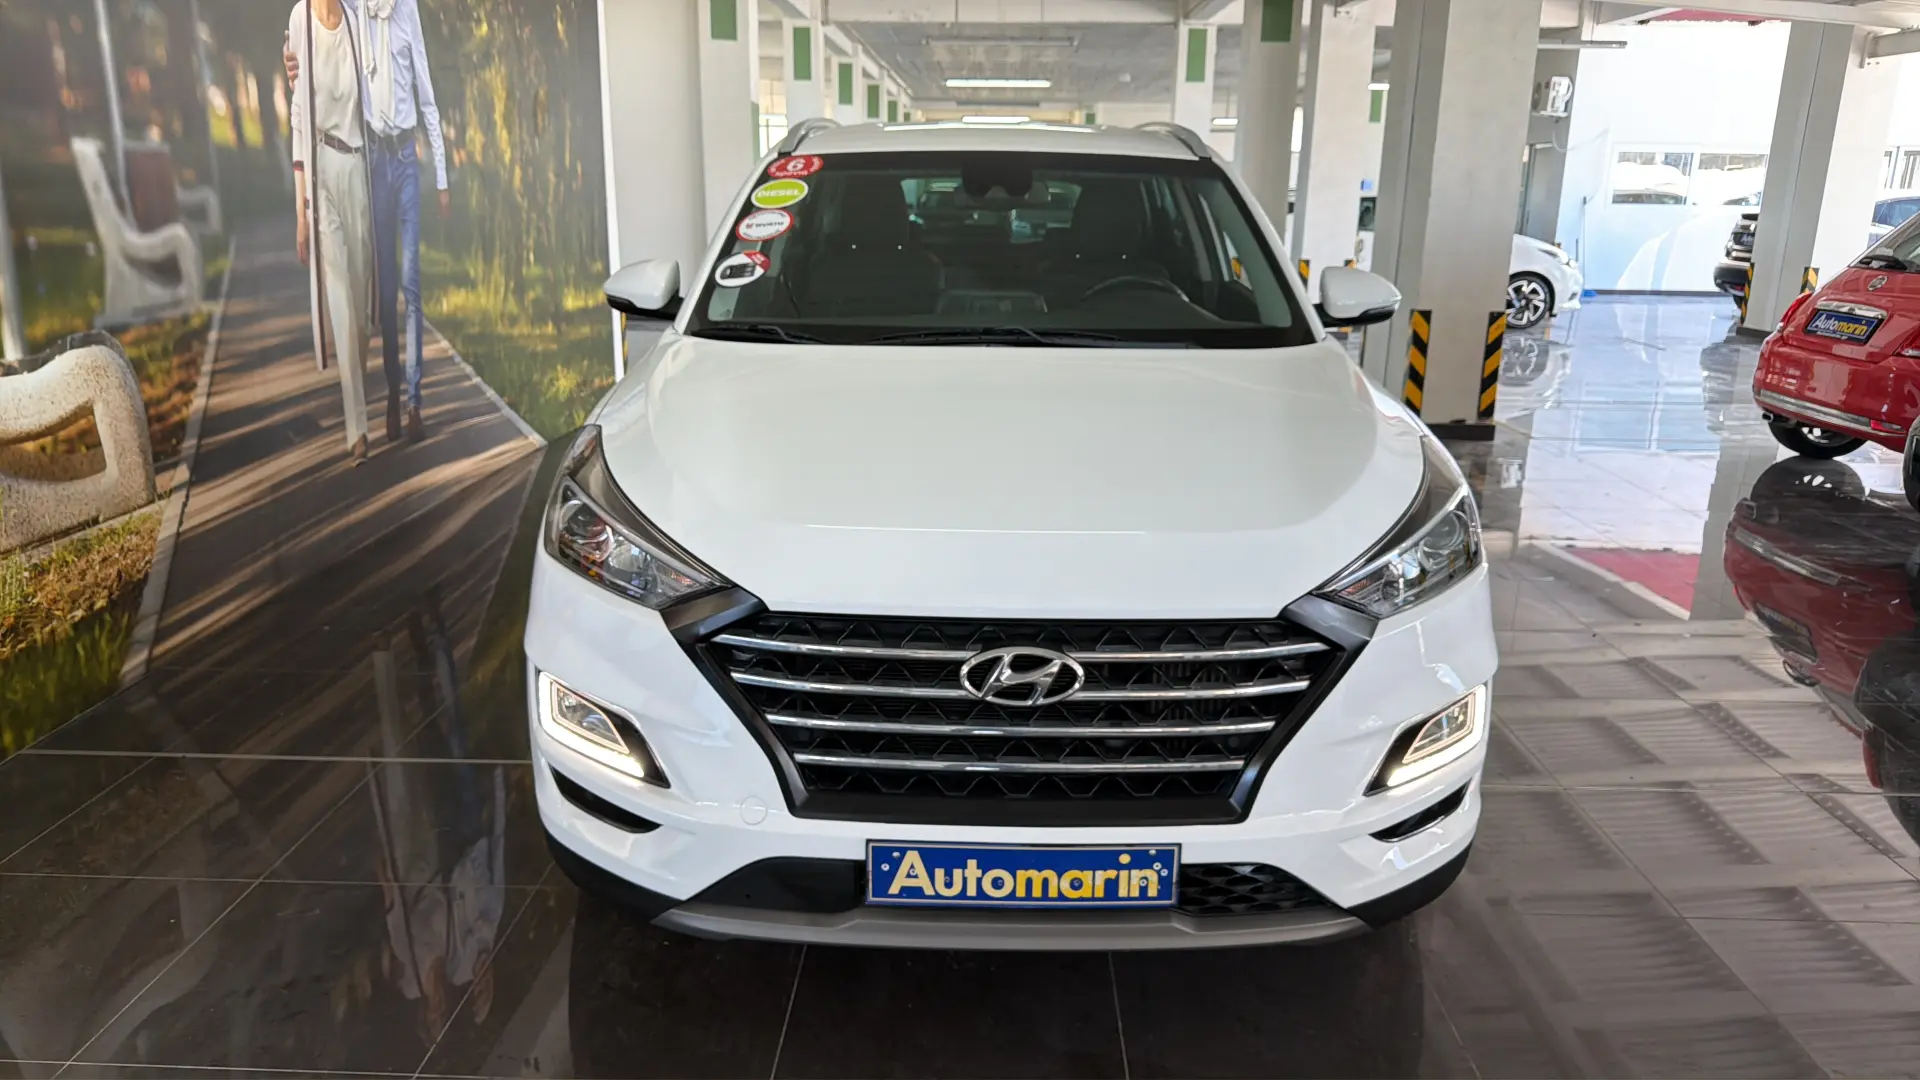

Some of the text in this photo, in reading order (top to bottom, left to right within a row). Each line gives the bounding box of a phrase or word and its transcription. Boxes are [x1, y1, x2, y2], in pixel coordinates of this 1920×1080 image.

[787, 158, 806, 171] 6
[757, 189, 799, 197] DIESEL
[1812, 314, 1867, 335] Automarin
[887, 850, 1159, 899] Automarin
